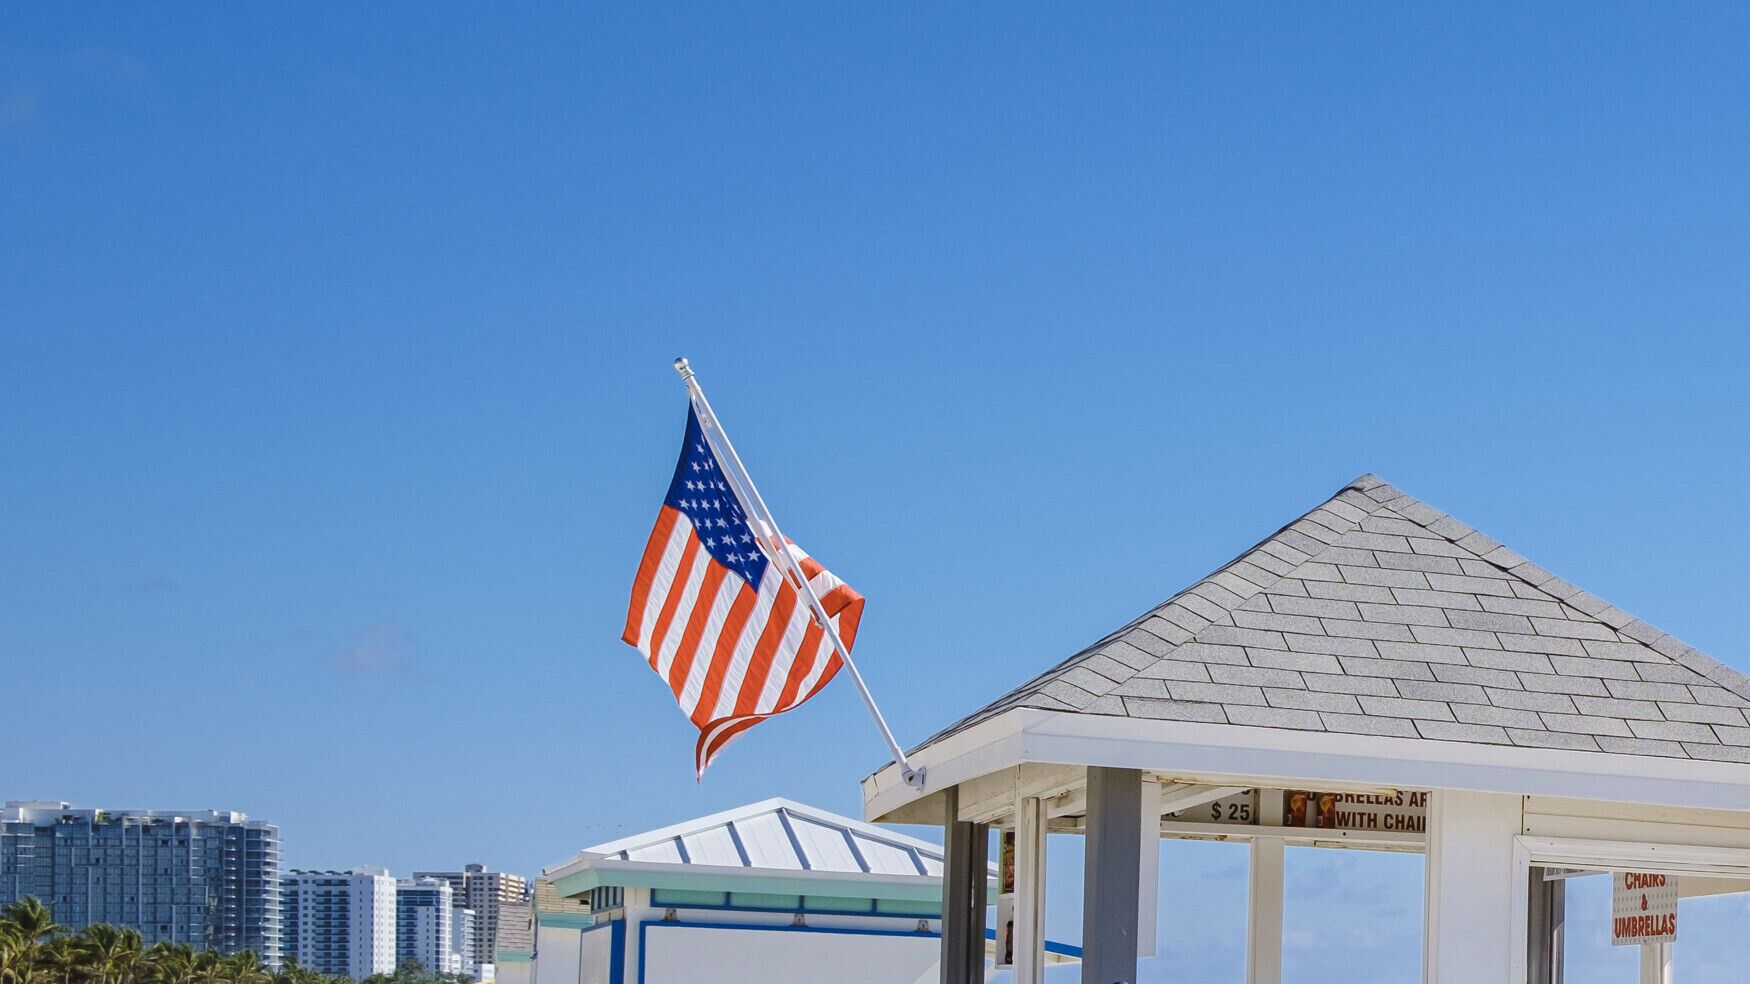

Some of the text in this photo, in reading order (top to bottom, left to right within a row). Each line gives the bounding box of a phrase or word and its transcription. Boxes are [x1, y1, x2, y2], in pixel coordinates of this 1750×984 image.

[1228, 803, 1250, 821] 25
[1335, 811, 1378, 829] WITH
[1614, 912, 1676, 939] UMBRELLAS
